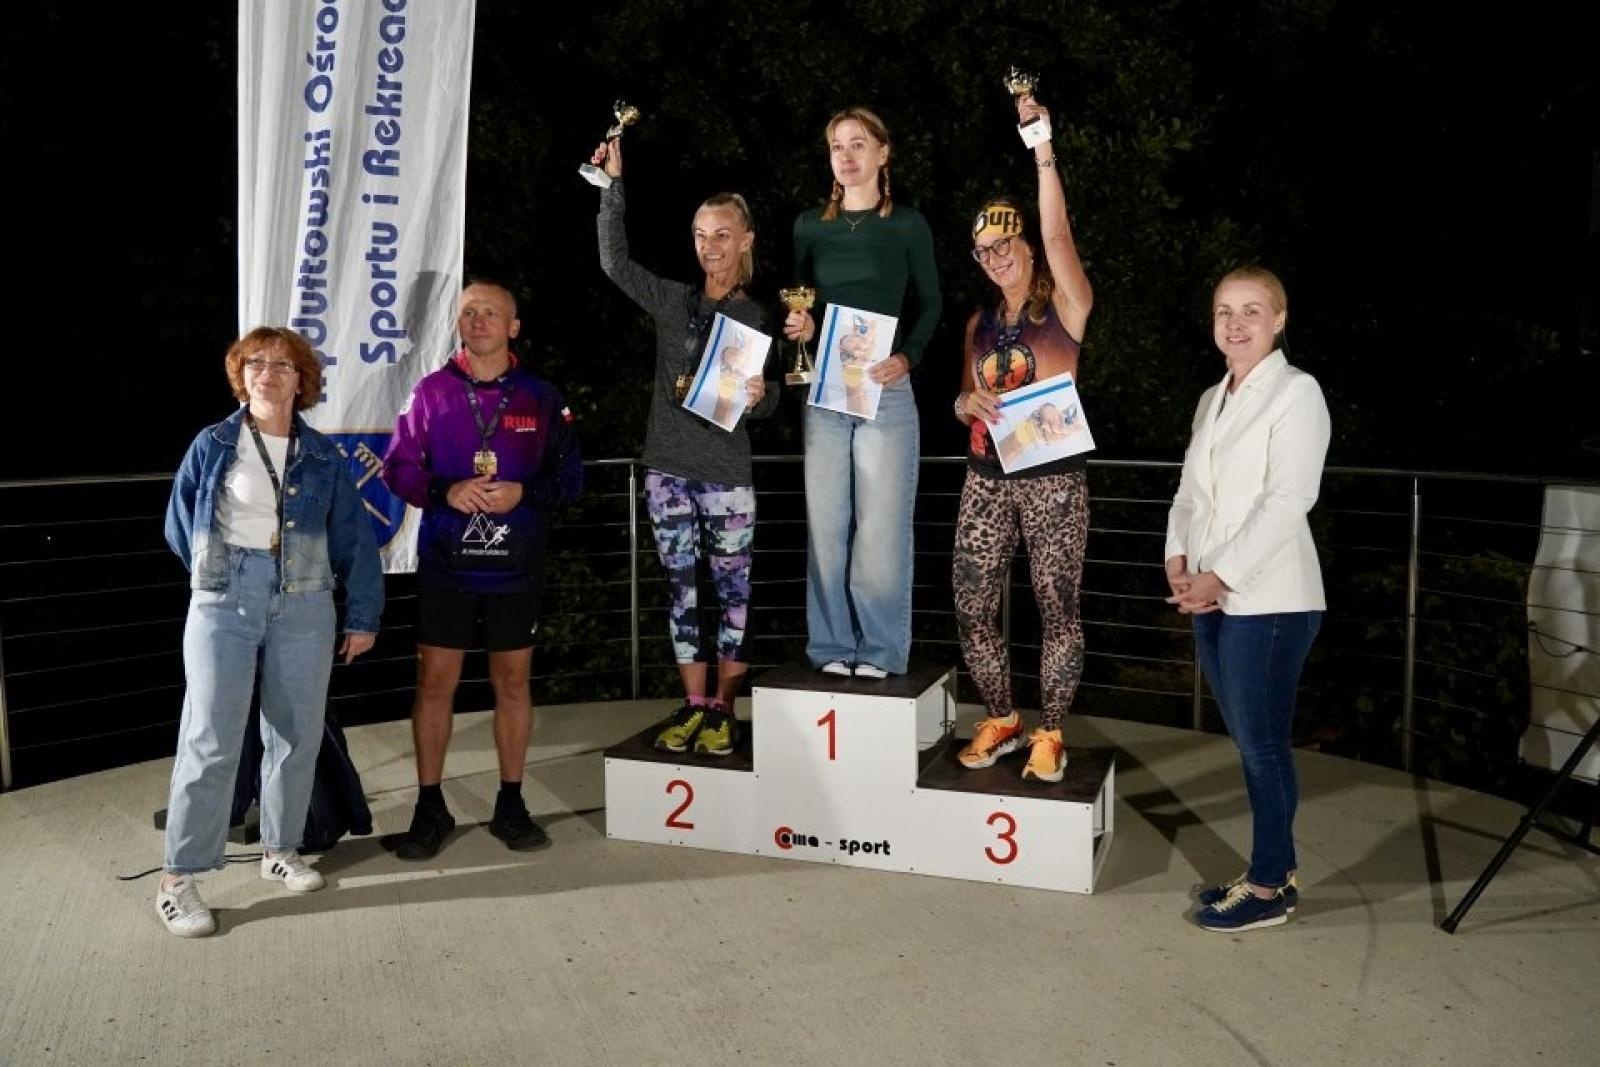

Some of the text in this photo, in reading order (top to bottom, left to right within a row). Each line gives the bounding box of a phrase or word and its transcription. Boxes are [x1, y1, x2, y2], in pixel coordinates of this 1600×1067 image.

[362, 193, 400, 205] i
[291, 129, 337, 402] dułtowski
[360, 221, 408, 363] Sportu
[505, 415, 536, 428] RUN
[817, 709, 837, 761] 1
[664, 779, 695, 830] 2
[839, 838, 891, 856] sport
[984, 811, 1019, 865] 3
